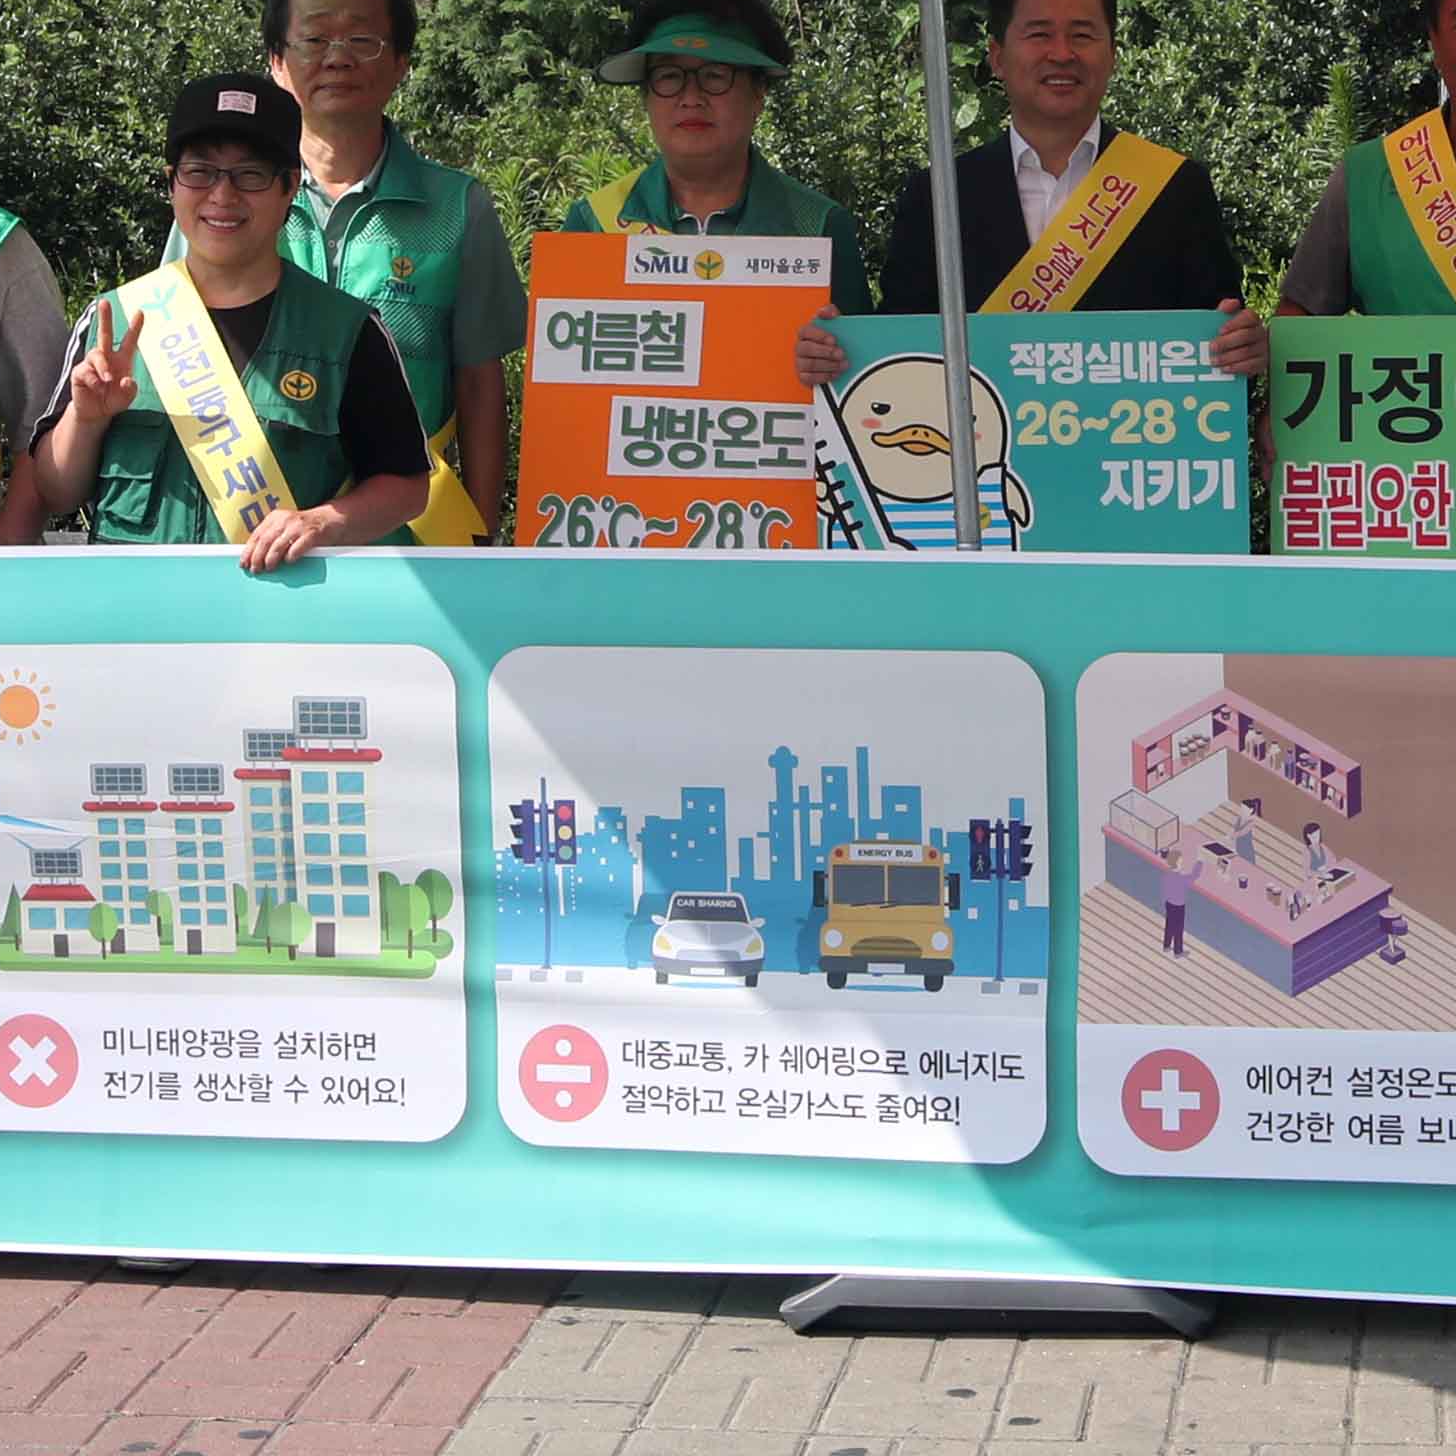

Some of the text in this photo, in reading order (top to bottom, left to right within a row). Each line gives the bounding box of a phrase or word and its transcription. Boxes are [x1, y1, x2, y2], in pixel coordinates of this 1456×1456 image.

[1400, 125, 1442, 194] 에너지
[1068, 175, 1139, 251] 에너지
[634, 247, 689, 276] SMU
[744, 257, 821, 275] 새마을운동
[546, 310, 687, 372] 여름철
[621, 405, 807, 470] 냉방온도
[1100, 459, 1236, 511] 지키기
[1280, 460, 1451, 550] 불필요한
[858, 849, 913, 858] ENERGY BUS
[676, 898, 737, 908] CAR SHARING
[103, 1028, 377, 1062] 미니태양광을 설치하면
[622, 1040, 1025, 1082] 대중교통, 카 쉐어링으로 에너지도
[103, 1071, 406, 1107] 전기를 생산할 수 있어요!
[1246, 1064, 1333, 1097] 에어컨
[621, 1085, 961, 1126] 절약하고 온실가스도 줄여요!
[1246, 1111, 1333, 1144] 건강한
[1347, 1114, 1405, 1145] 여름
